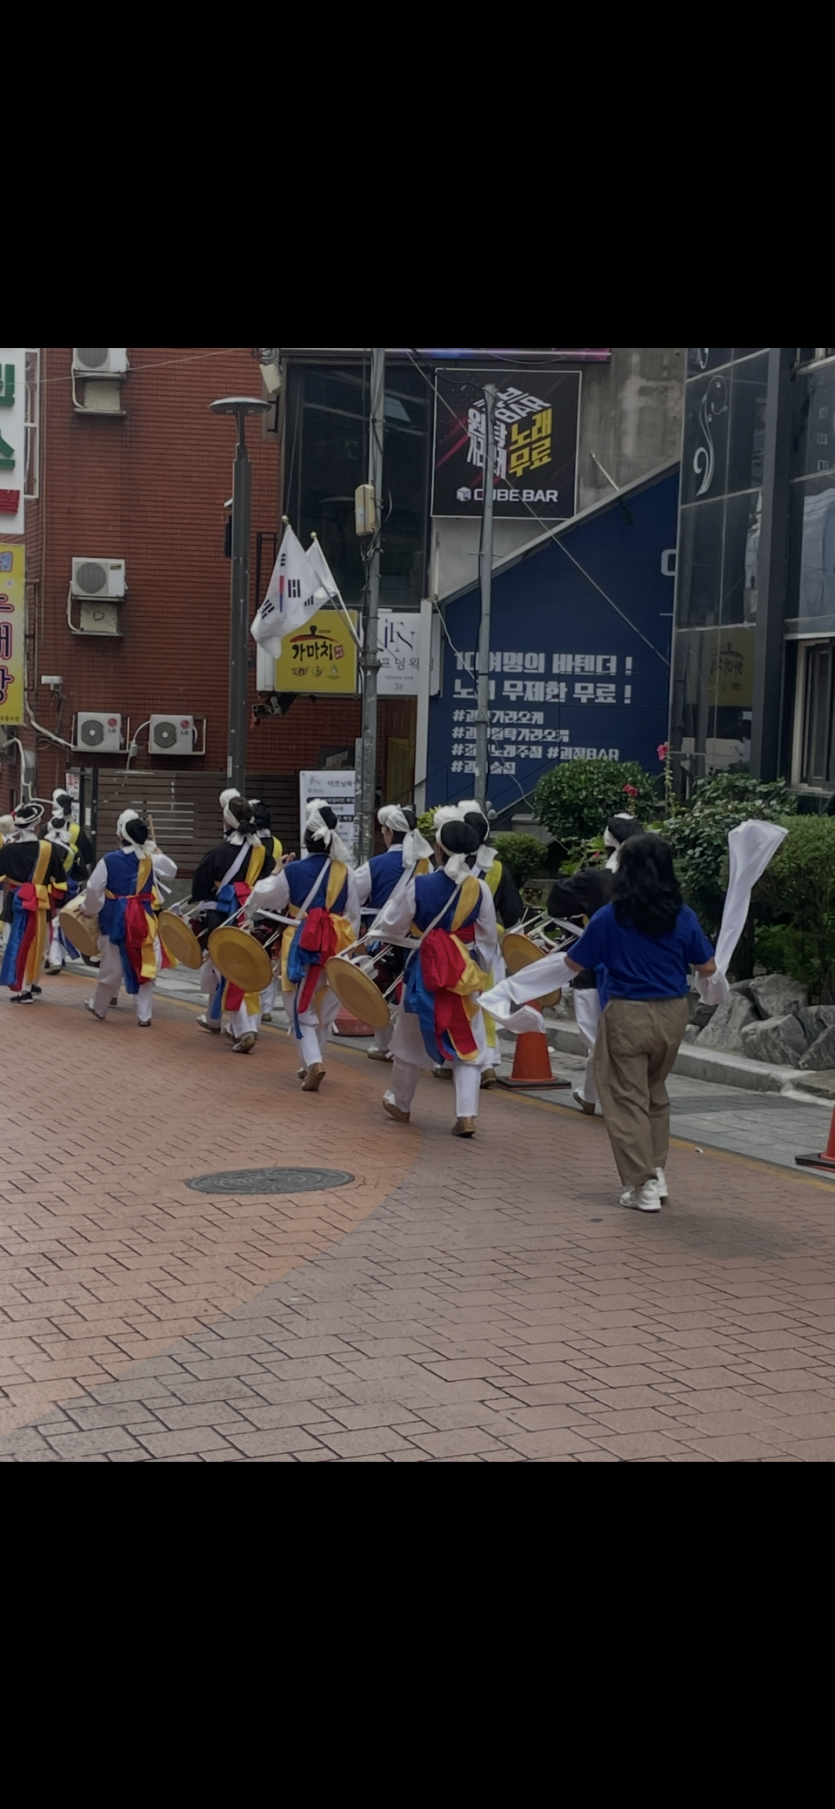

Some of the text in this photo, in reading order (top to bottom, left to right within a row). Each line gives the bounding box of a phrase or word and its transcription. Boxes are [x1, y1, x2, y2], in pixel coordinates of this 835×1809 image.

[494, 395, 552, 424] BAR
[509, 407, 552, 450] 노래
[508, 437, 552, 478] 무료
[473, 488, 559, 502] CBE BAR
[292, 640, 333, 662] 가마치
[552, 653, 617, 676] 바텐더
[625, 656, 633, 676] !
[502, 680, 568, 702] 무제한
[573, 682, 617, 703] 무료
[624, 684, 632, 704] !
[452, 709, 544, 725] #괴가라오케
[452, 726, 570, 743] #괴원탁가라오케
[451, 743, 543, 759] #괴노래주점
[450, 760, 516, 775] #괴술집
